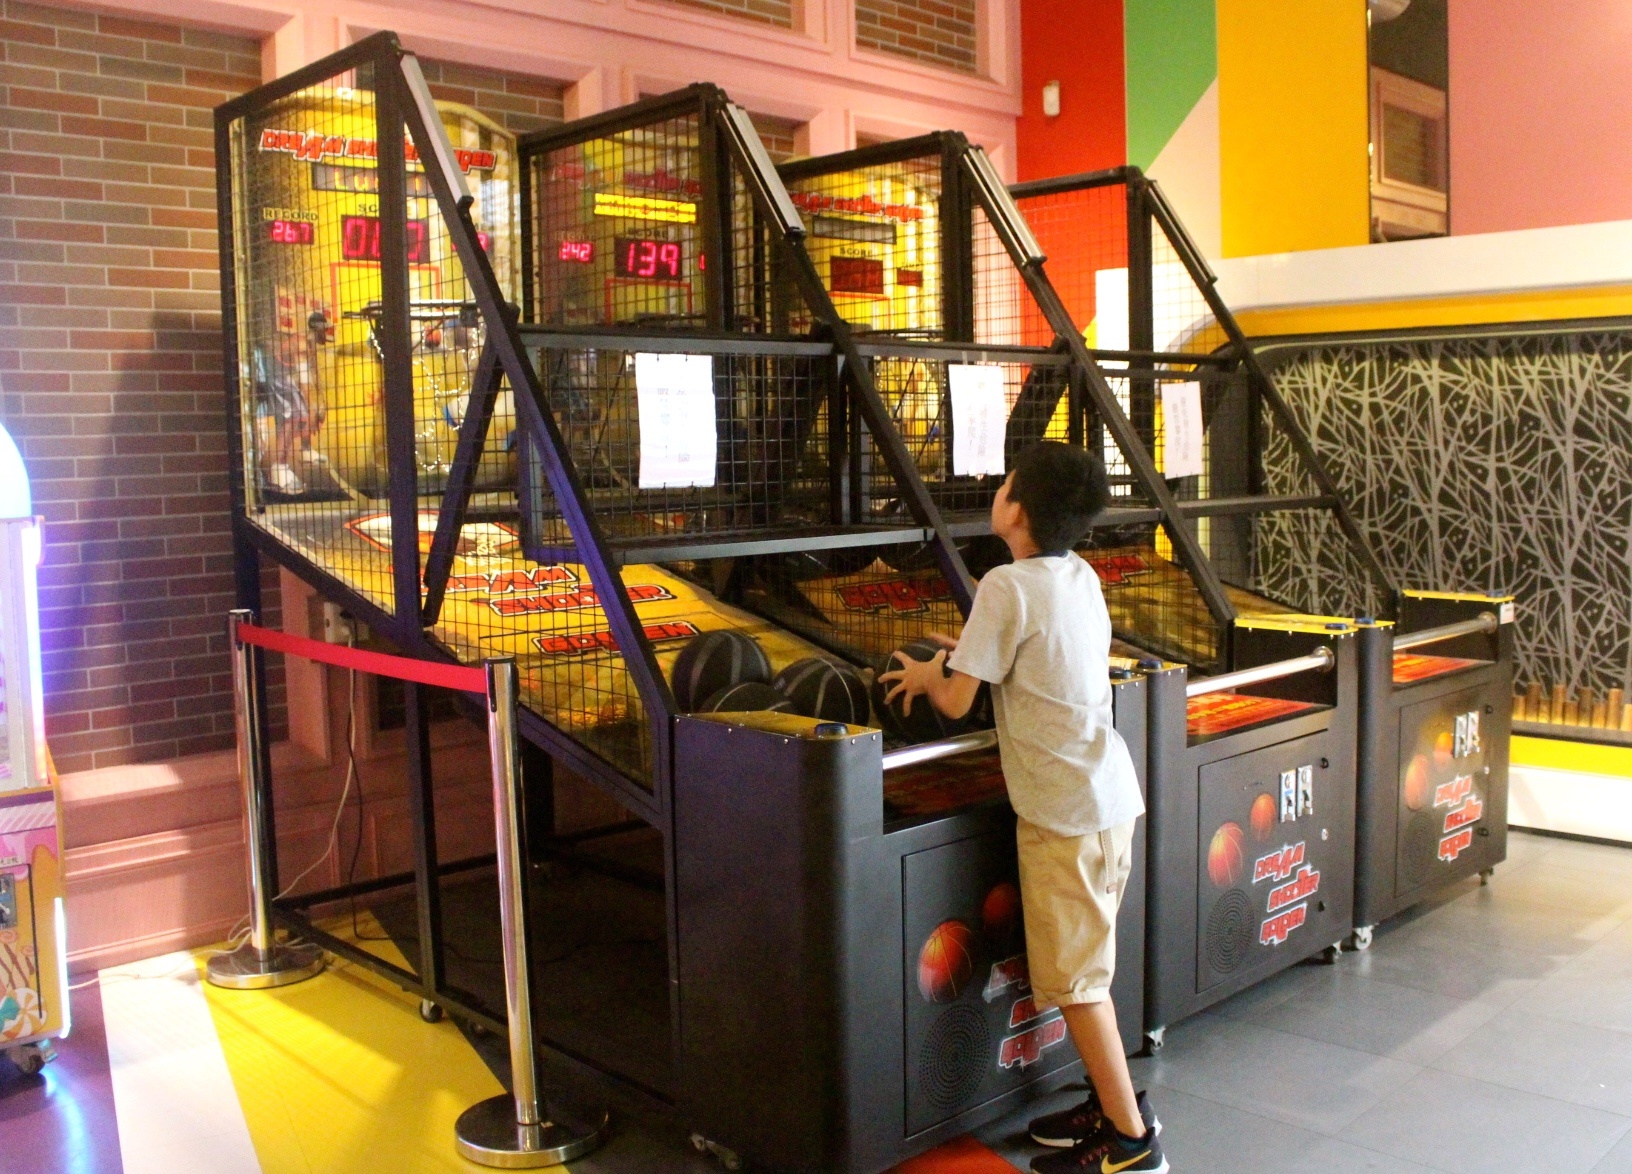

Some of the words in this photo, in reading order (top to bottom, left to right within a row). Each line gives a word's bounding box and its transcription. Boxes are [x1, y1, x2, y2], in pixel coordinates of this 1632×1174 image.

[272, 221, 310, 242] 267
[627, 241, 679, 277] 139
[840, 246, 873, 258] SCORE
[488, 583, 673, 617] SHOOER
[531, 620, 700, 656] GOLEN
